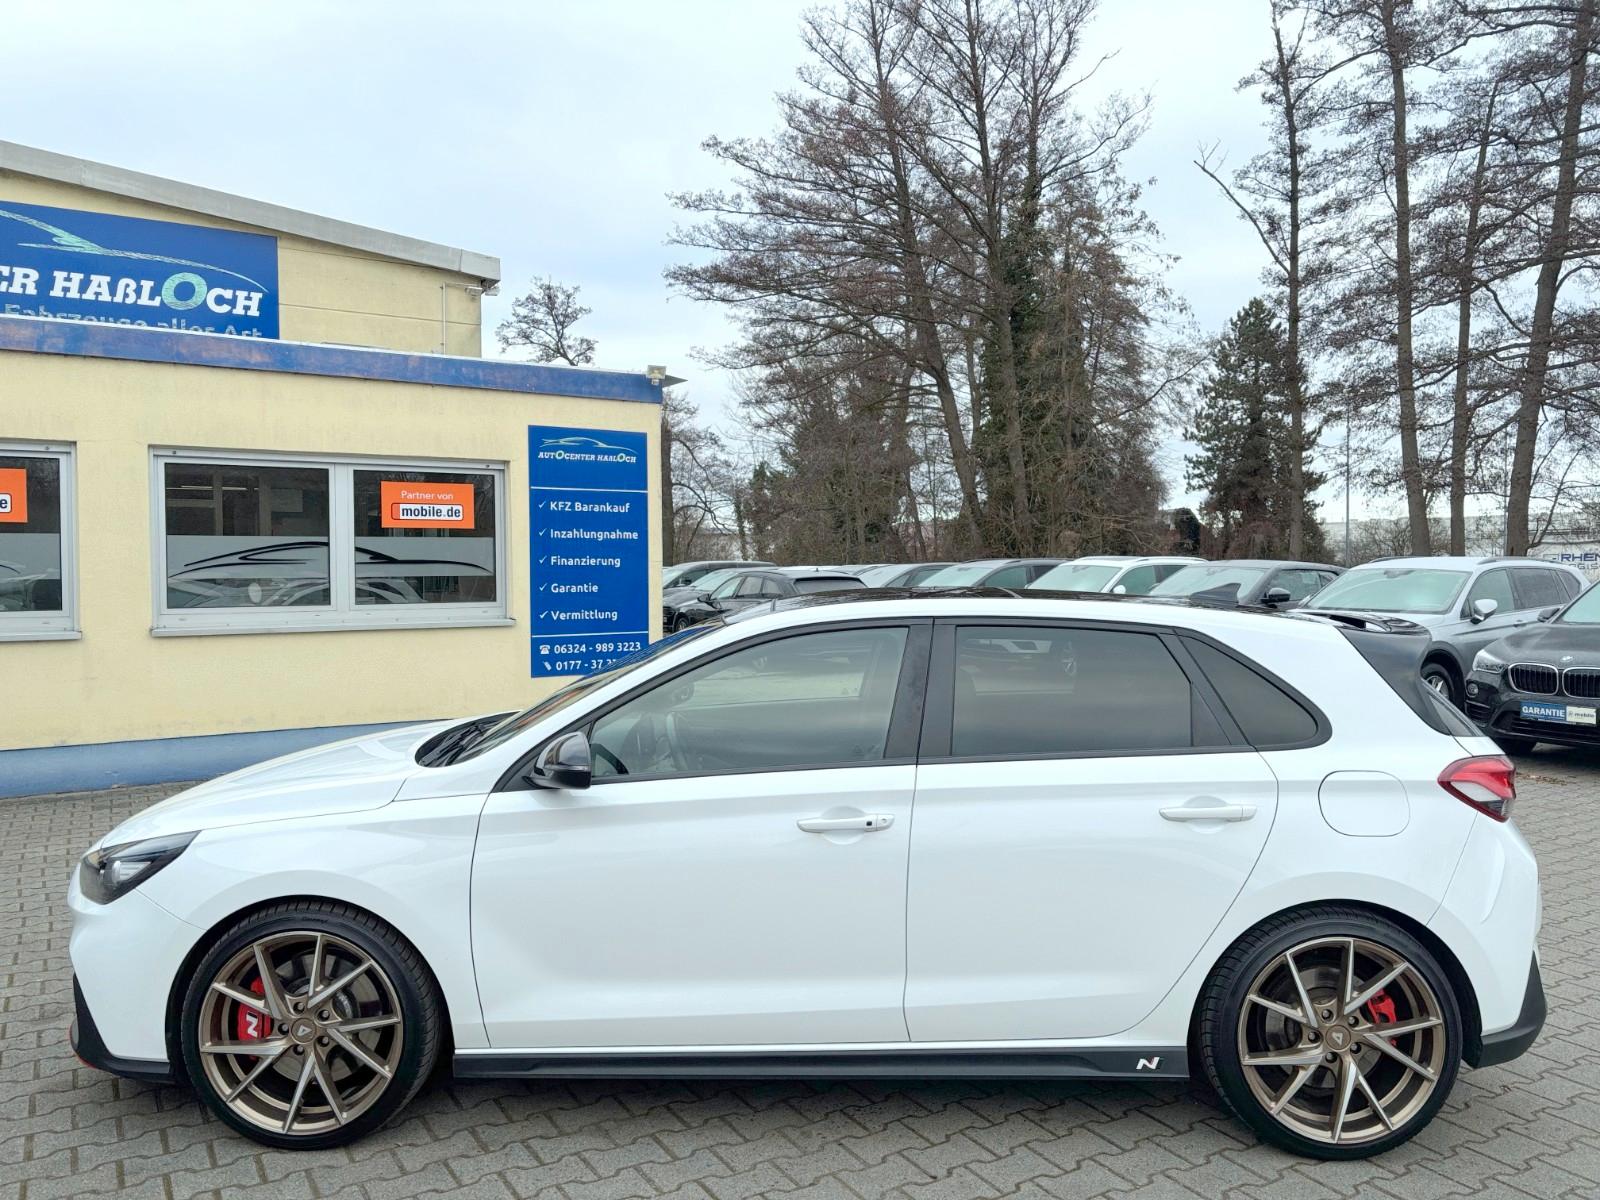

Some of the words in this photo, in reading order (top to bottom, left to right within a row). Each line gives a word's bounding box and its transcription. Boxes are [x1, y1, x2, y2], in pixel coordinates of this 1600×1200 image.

[538, 450, 595, 461] AUTOCENTER
[400, 490, 434, 500] Partner
[401, 506, 461, 518] mobile.de
[550, 501, 572, 511] KFZ
[574, 502, 630, 513] Barankauf
[550, 528, 639, 541] Inzahlungnahme
[550, 555, 621, 568] Finanzierung
[551, 582, 599, 593] Garantie
[550, 609, 618, 621] Vermittlung
[553, 644, 586, 654] 06324
[595, 643, 614, 653] 989
[616, 641, 641, 652] 3223
[555, 660, 581, 671] 0177
[1522, 705, 1565, 717] GARANTIE
[1135, 1056, 1160, 1070] N
